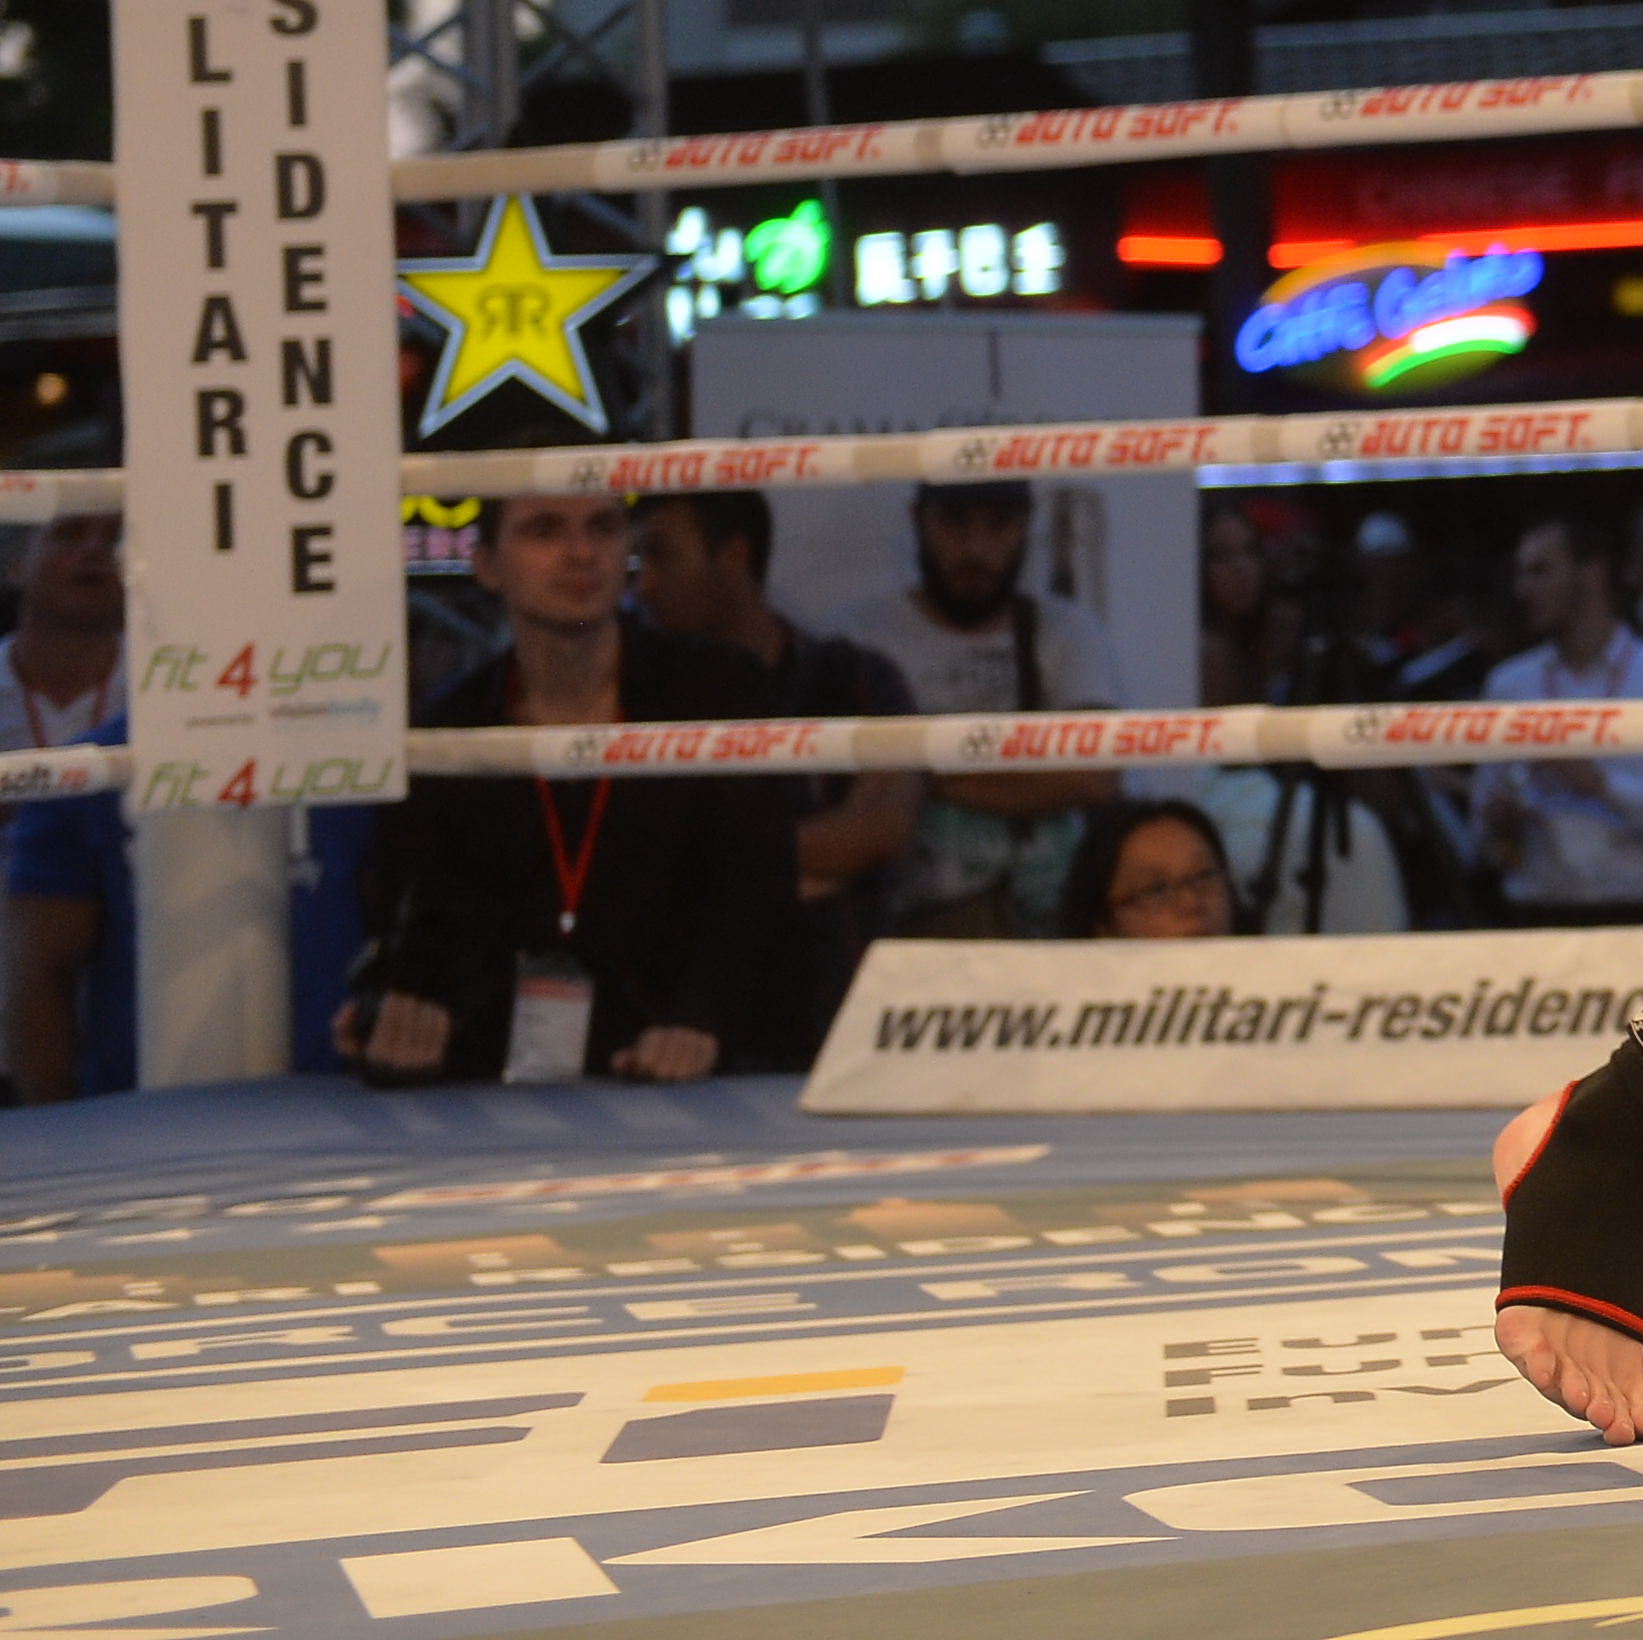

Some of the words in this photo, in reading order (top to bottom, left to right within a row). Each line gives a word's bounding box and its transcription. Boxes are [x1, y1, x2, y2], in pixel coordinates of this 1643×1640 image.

[214, 641, 259, 700] 4
[267, 641, 394, 697] you
[0, 1291, 818, 1371] ORCE
